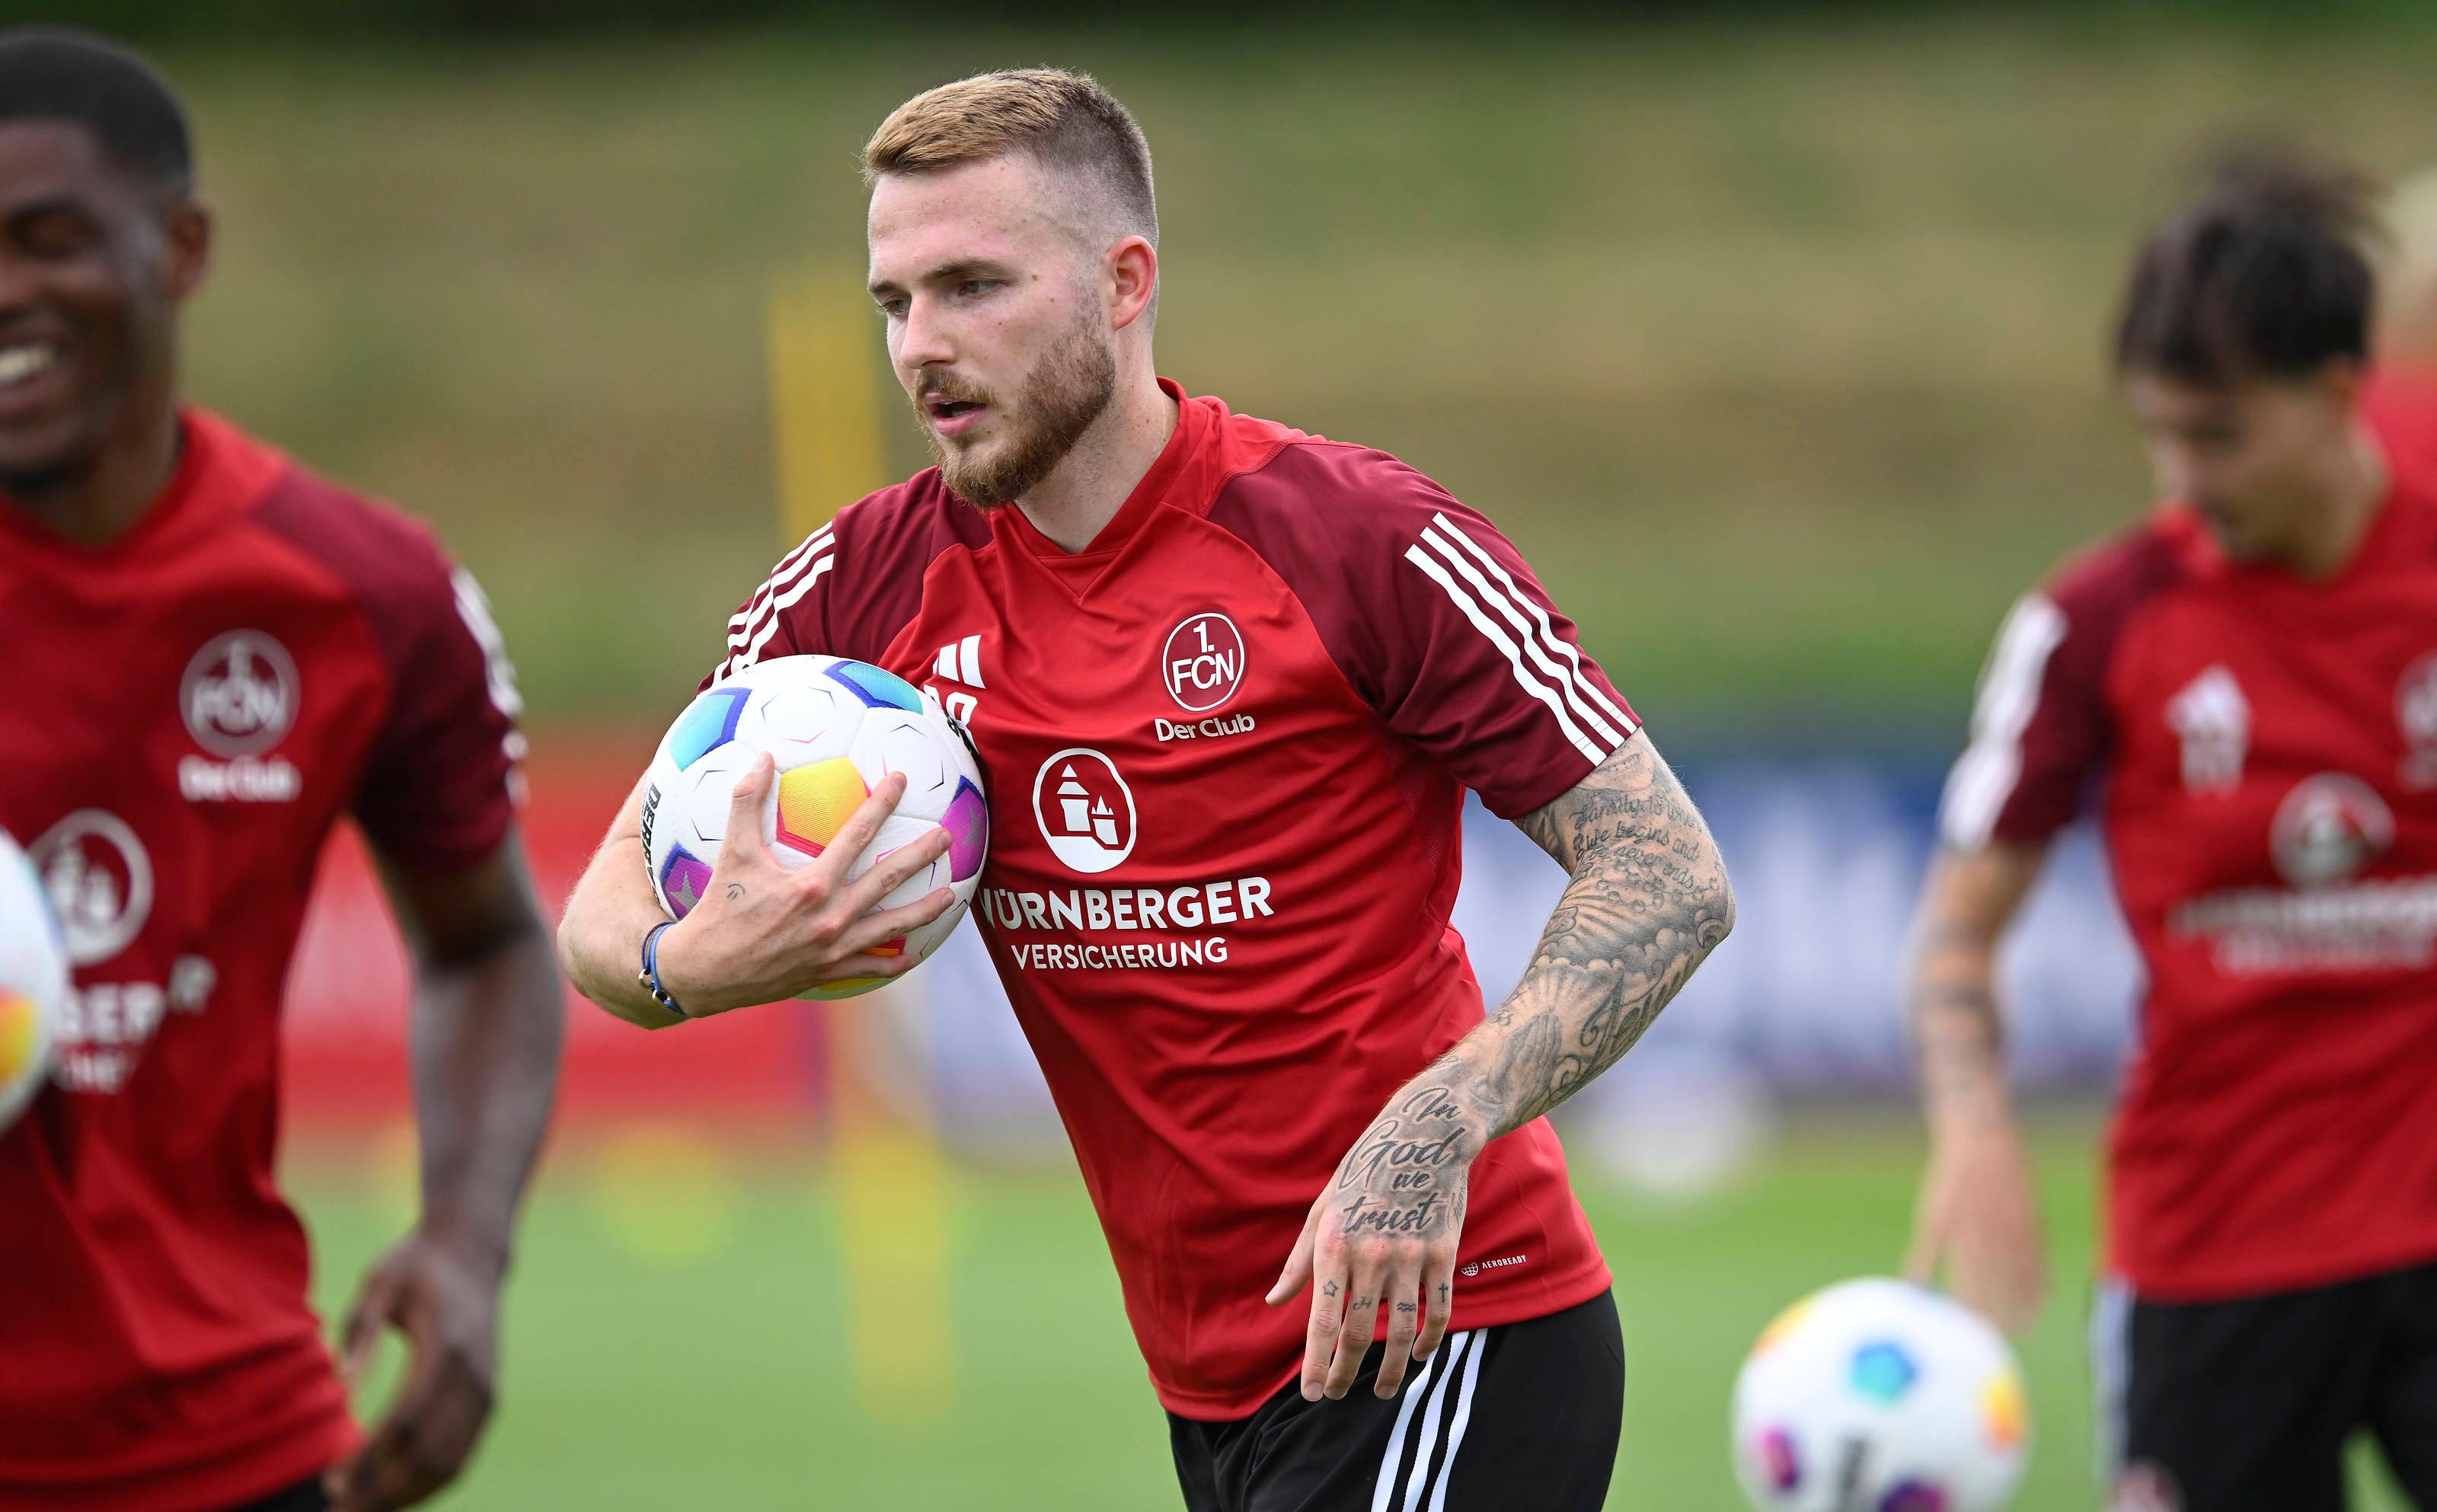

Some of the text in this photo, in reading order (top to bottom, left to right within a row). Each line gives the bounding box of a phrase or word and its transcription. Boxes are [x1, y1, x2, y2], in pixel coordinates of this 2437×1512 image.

[1193, 620, 1215, 653] 1.
[1172, 648, 1234, 694] FCN
[1154, 713, 1256, 742] Der Club
[978, 876, 1274, 930] NÜRNBERGER
[1011, 936, 1228, 970] VERSICHERUNG
[1402, 1087, 1461, 1122] In
[1338, 1120, 1466, 1190] God
[1392, 1171, 1430, 1190] we
[1343, 1192, 1444, 1233] trust
[1482, 1255, 1526, 1269] AEROREADY
